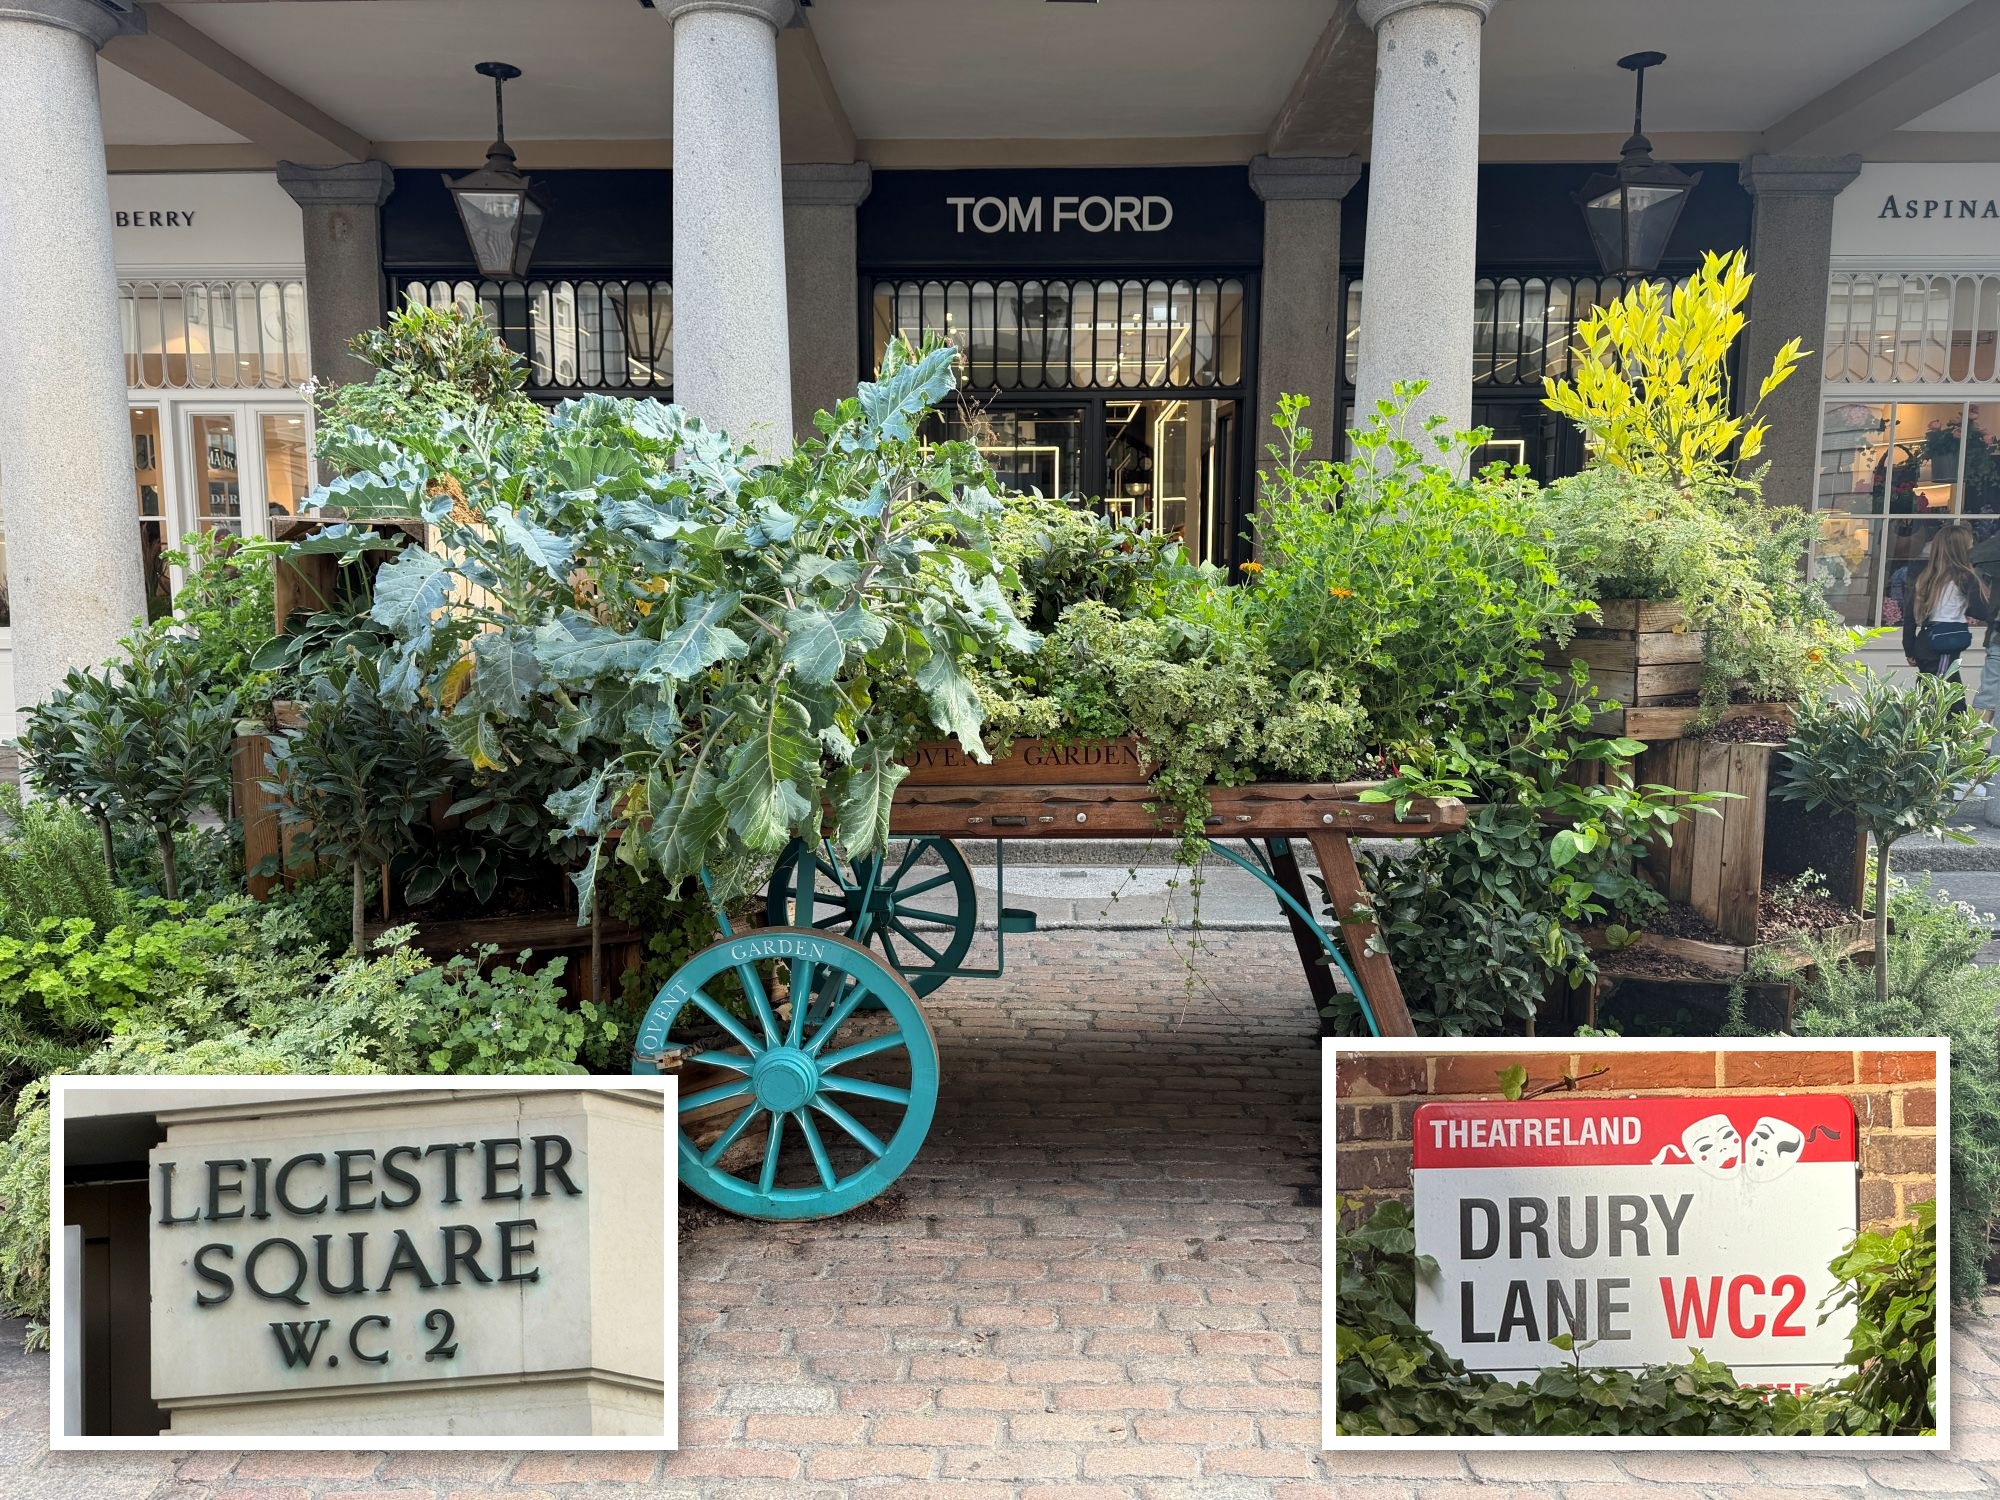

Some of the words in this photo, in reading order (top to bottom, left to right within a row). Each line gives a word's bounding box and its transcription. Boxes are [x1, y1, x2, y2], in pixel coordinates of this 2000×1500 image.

[115, 211, 196, 227] BERRY
[946, 196, 1042, 233] TOM
[1053, 195, 1174, 233] FORD
[1877, 194, 2000, 219] ASPINA
[900, 747, 999, 768] OVEN
[1023, 744, 1142, 767] GARDEN
[640, 979, 689, 1056] OVENT
[731, 939, 825, 960] GARDEN
[1429, 1115, 1642, 1149] THEATRELAND
[157, 1134, 583, 1224] LEICESTER
[1459, 1193, 1695, 1261] DRURY
[193, 1218, 540, 1306] SQUARE
[1461, 1277, 1632, 1343] LANE
[1659, 1274, 1808, 1340] WC2
